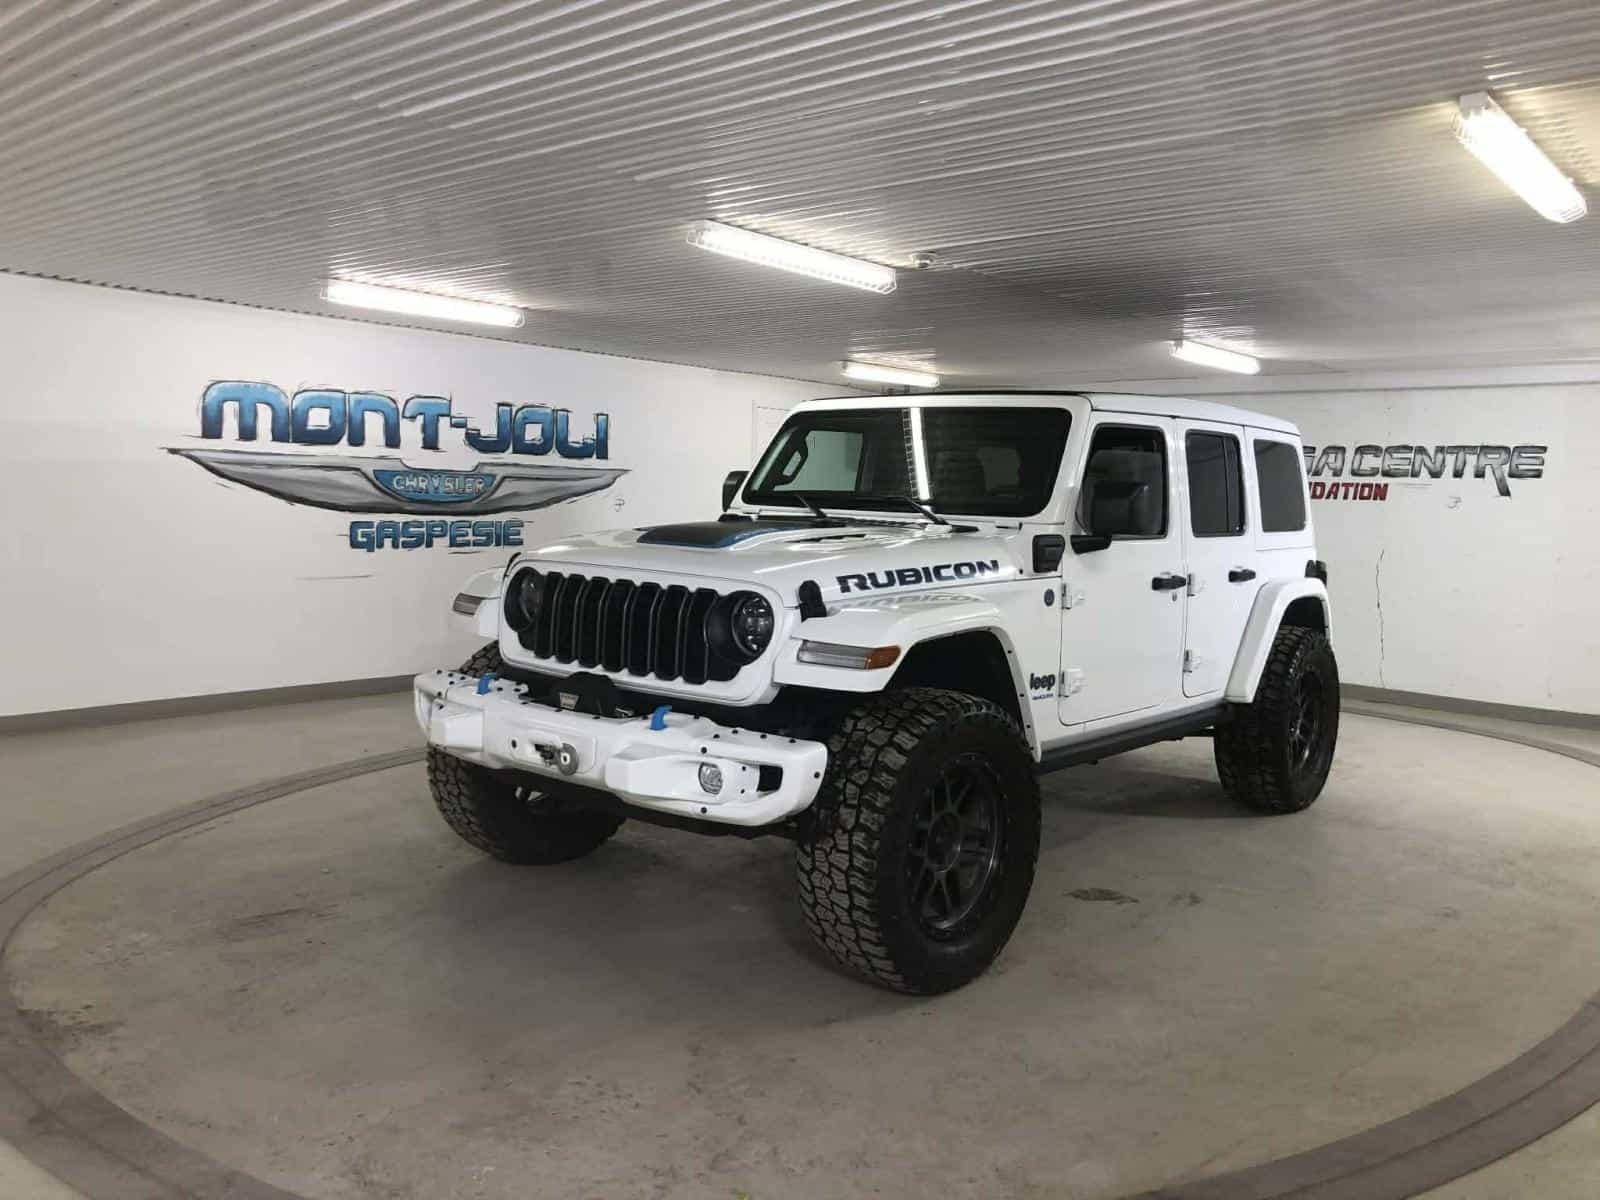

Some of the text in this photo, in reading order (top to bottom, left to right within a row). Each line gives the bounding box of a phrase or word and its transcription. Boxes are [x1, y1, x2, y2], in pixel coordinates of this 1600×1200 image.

[393, 474, 484, 494] CHRYSLER
[1351, 445, 1548, 497] CENTRE
[1309, 482, 1388, 500] DATION
[349, 519, 524, 552] GASPESIE
[836, 560, 999, 593] RUBICON
